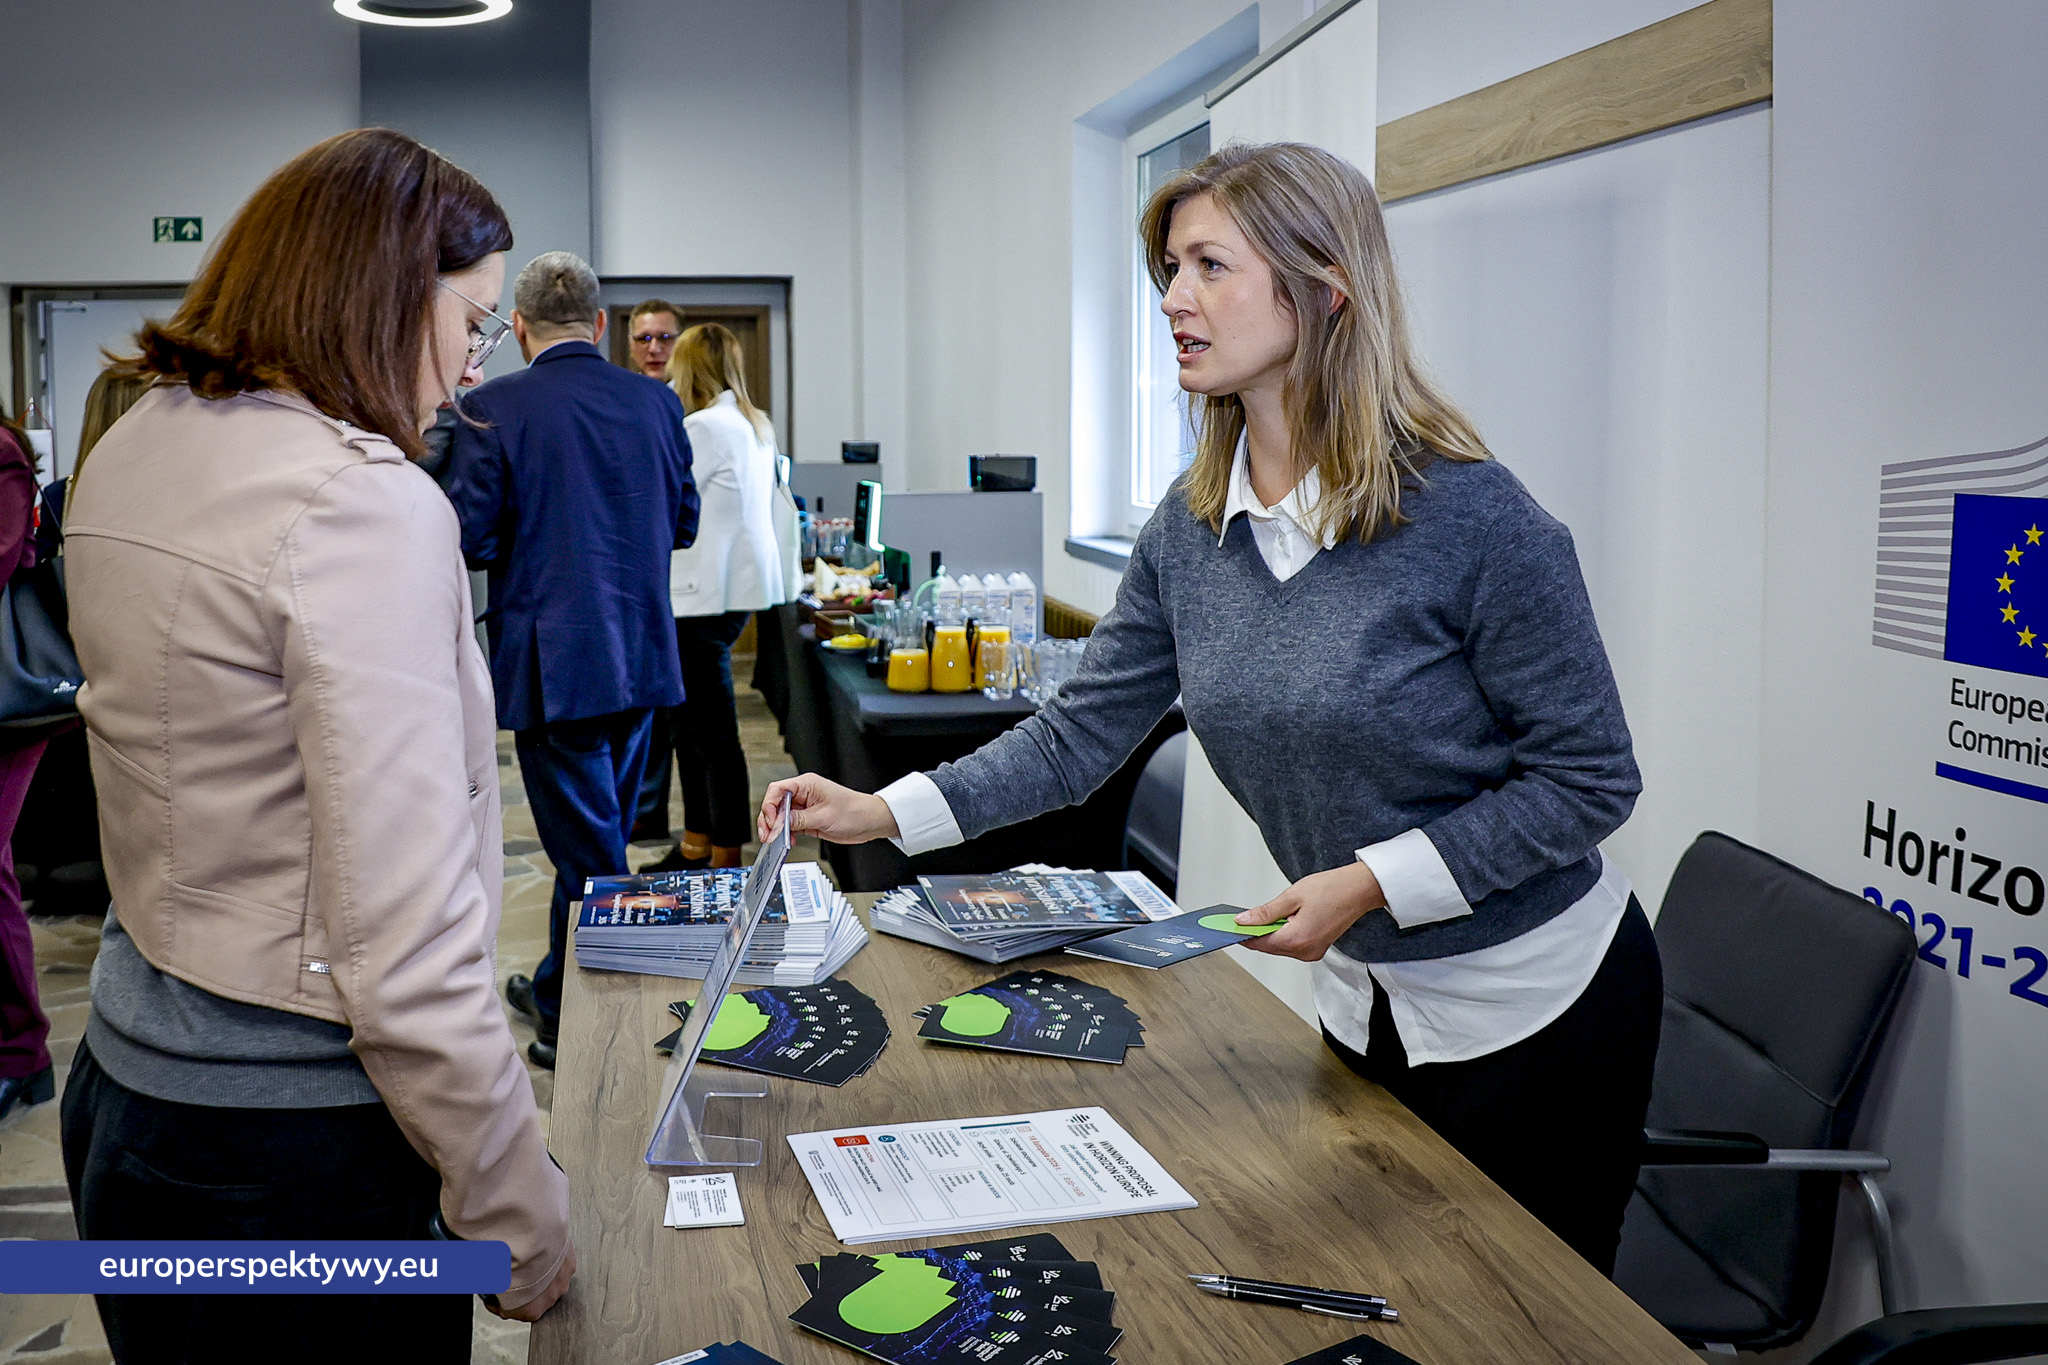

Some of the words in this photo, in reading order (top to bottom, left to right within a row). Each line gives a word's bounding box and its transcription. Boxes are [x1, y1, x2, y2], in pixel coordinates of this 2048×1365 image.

[1951, 677, 2048, 725] Europe
[1863, 800, 2046, 916] Horizo
[1863, 887, 2048, 1008] 21-2
[1090, 1150, 1120, 1174] HORIZON
[1114, 1175, 1142, 1198] EUROPE
[1100, 1141, 1128, 1165] WINNING
[1123, 1166, 1157, 1196] PROPOSAL
